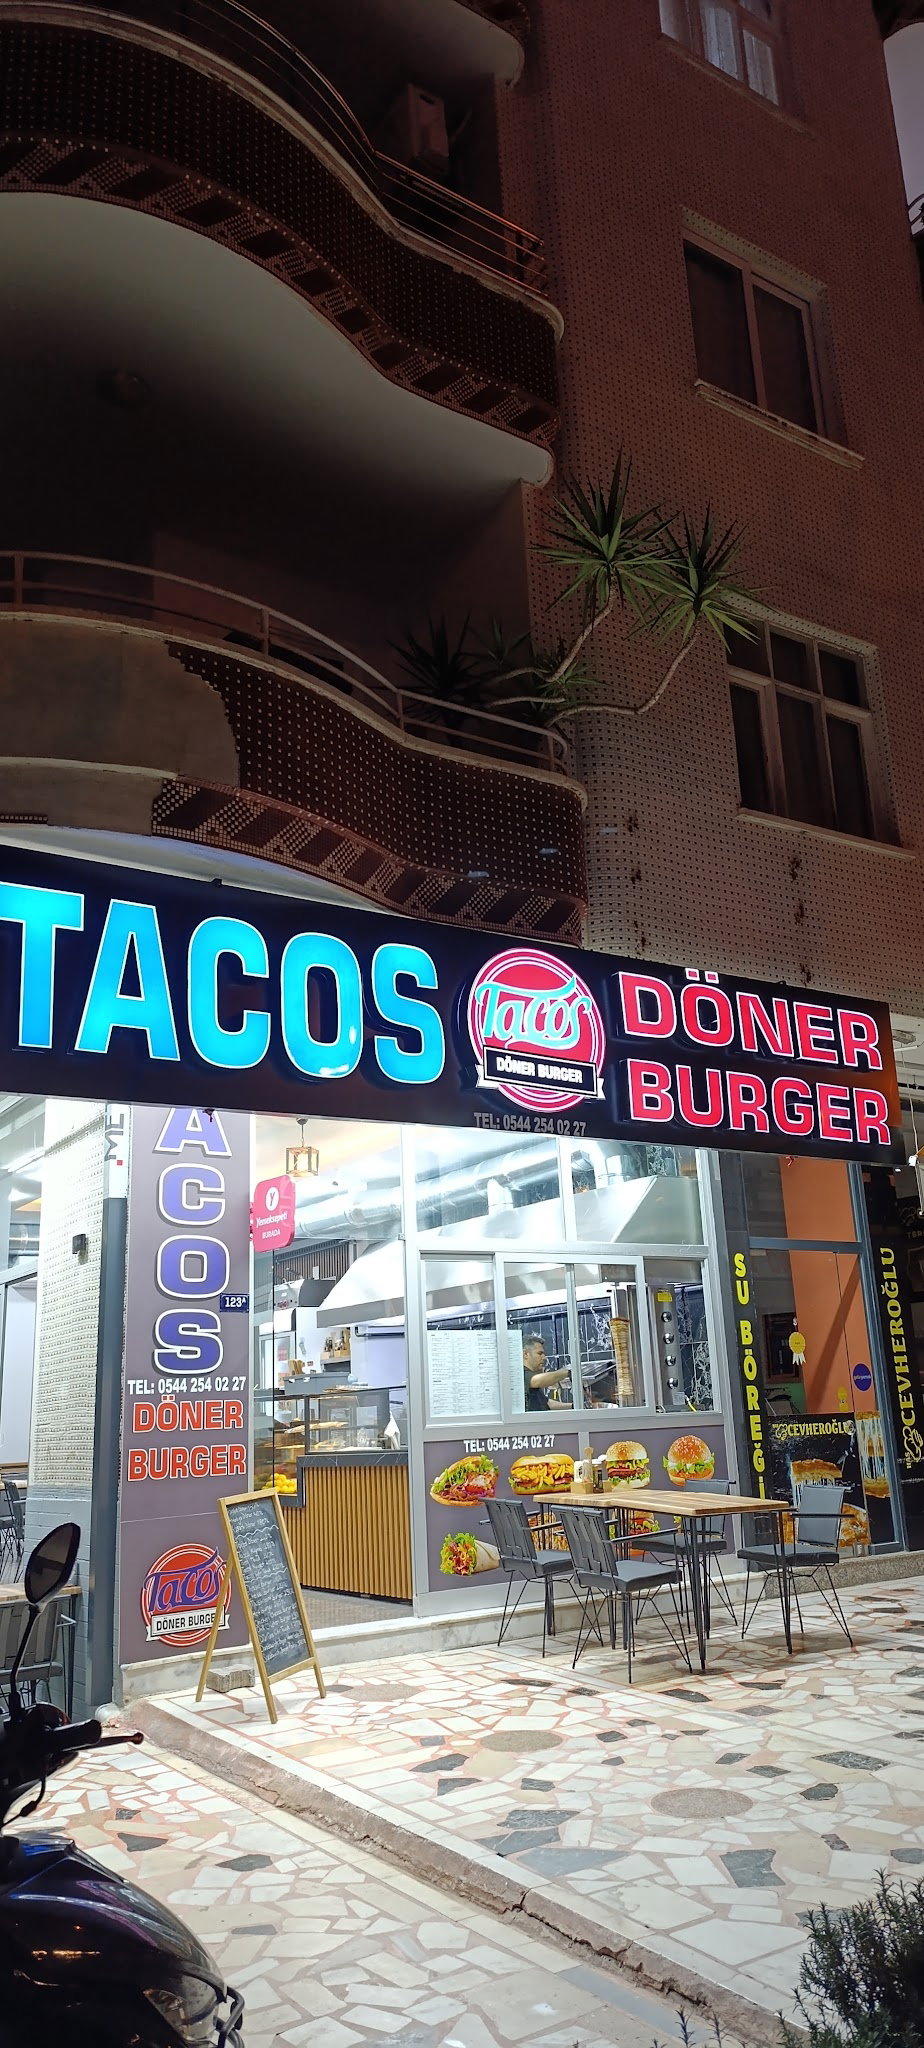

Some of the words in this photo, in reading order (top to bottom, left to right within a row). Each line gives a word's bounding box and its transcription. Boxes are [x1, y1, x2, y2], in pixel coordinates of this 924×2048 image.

[0, 881, 446, 1084] TACOS
[475, 975, 592, 1050] Tacos
[618, 967, 883, 1070] DÖNER
[496, 1055, 536, 1078] DÖNER
[537, 1063, 583, 1084] BURGER
[474, 1112, 501, 1129] TEL:
[503, 1114, 531, 1131] 0544
[534, 1117, 554, 1134] 254
[557, 1119, 570, 1135] 02
[573, 1121, 586, 1137] 27
[627, 1058, 891, 1145] BURGER
[152, 1107, 232, 1375] ACOS
[734, 1253, 749, 1305] SU
[880, 1247, 916, 1427] CEVHEROĞLU
[127, 1380, 155, 1395] TEL:
[158, 1378, 187, 1394] 0544
[190, 1377, 212, 1393] 254
[215, 1376, 230, 1392] 02
[232, 1376, 246, 1391] 27
[133, 1394, 243, 1433] DÖNER
[128, 1444, 246, 1481] BURGER
[464, 1439, 485, 1453] TEL:
[487, 1438, 510, 1452] 0544
[512, 1436, 529, 1450] 254
[531, 1435, 542, 1449] 02
[544, 1434, 555, 1448] 27
[144, 1546, 227, 1612] Tacos
[156, 1616, 186, 1631] DÖNER
[189, 1613, 215, 1627] BURGE
